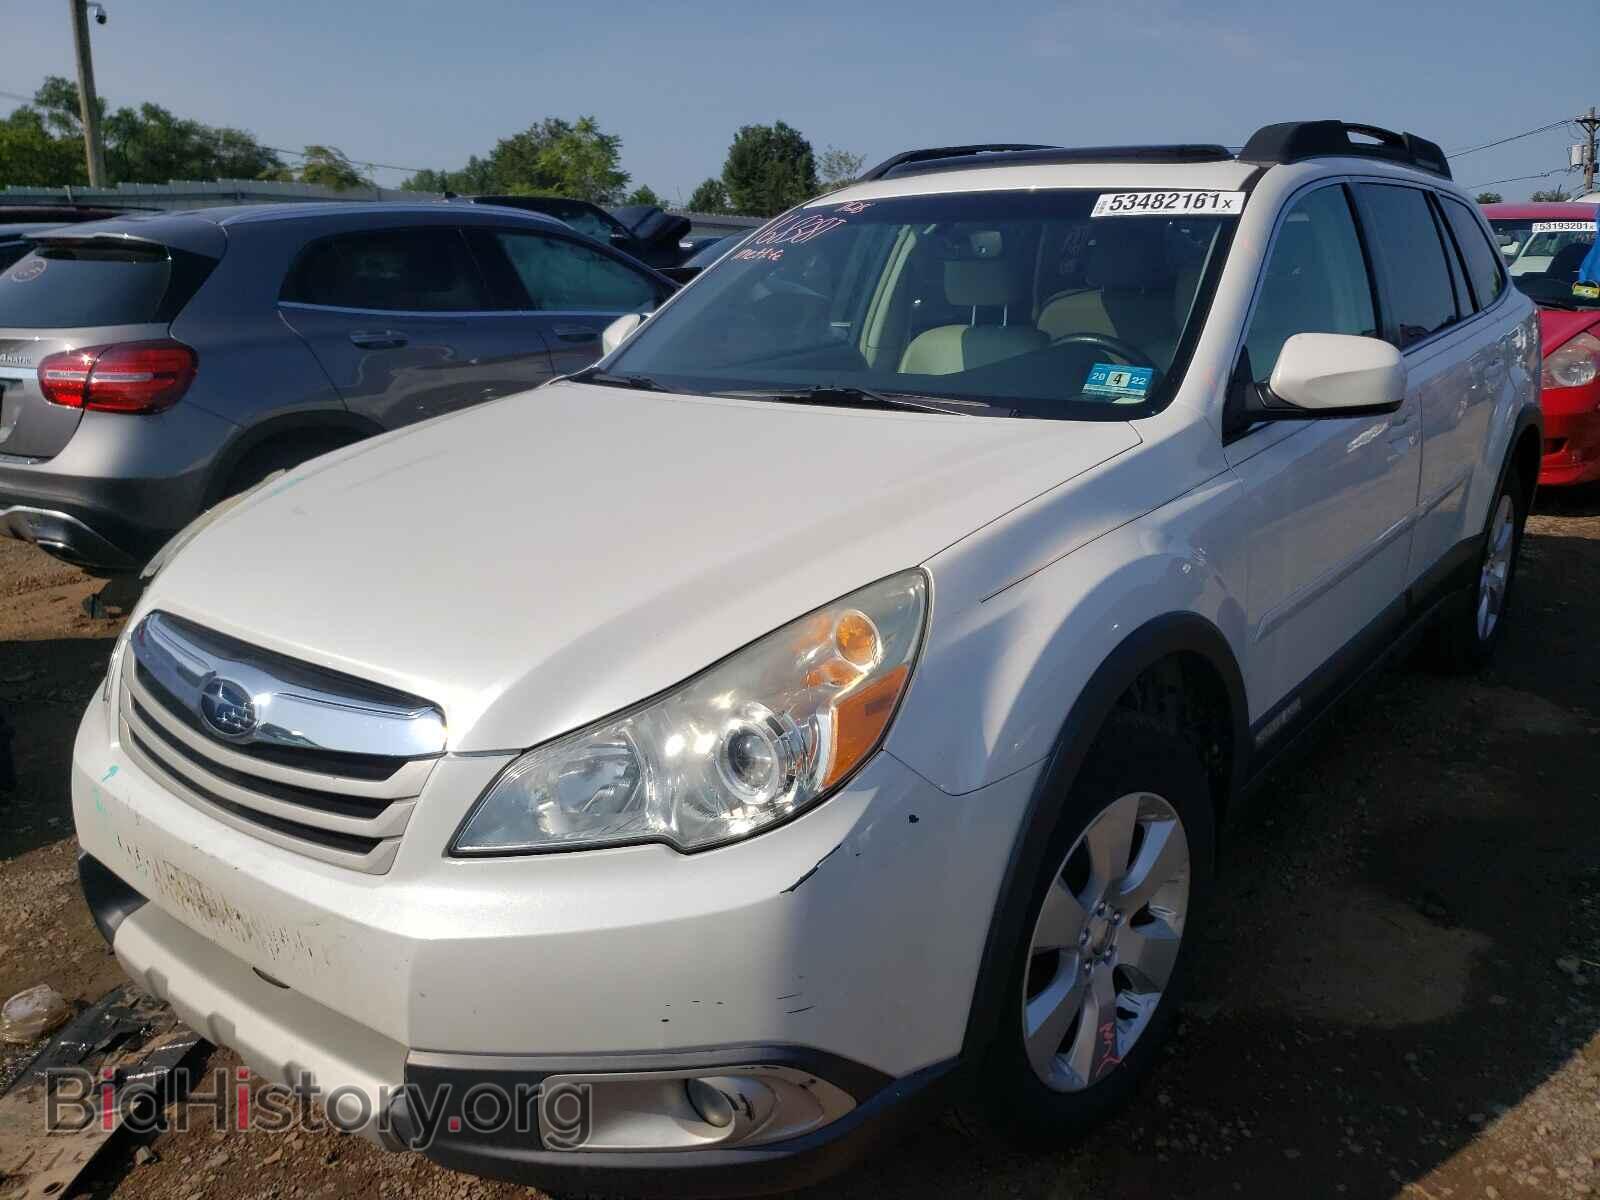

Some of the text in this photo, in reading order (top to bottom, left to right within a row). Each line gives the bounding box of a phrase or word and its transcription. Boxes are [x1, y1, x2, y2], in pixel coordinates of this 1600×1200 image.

[1109, 193, 1220, 211] 53482161
[1112, 373, 1122, 384] 4
[1131, 377, 1146, 385] 22
